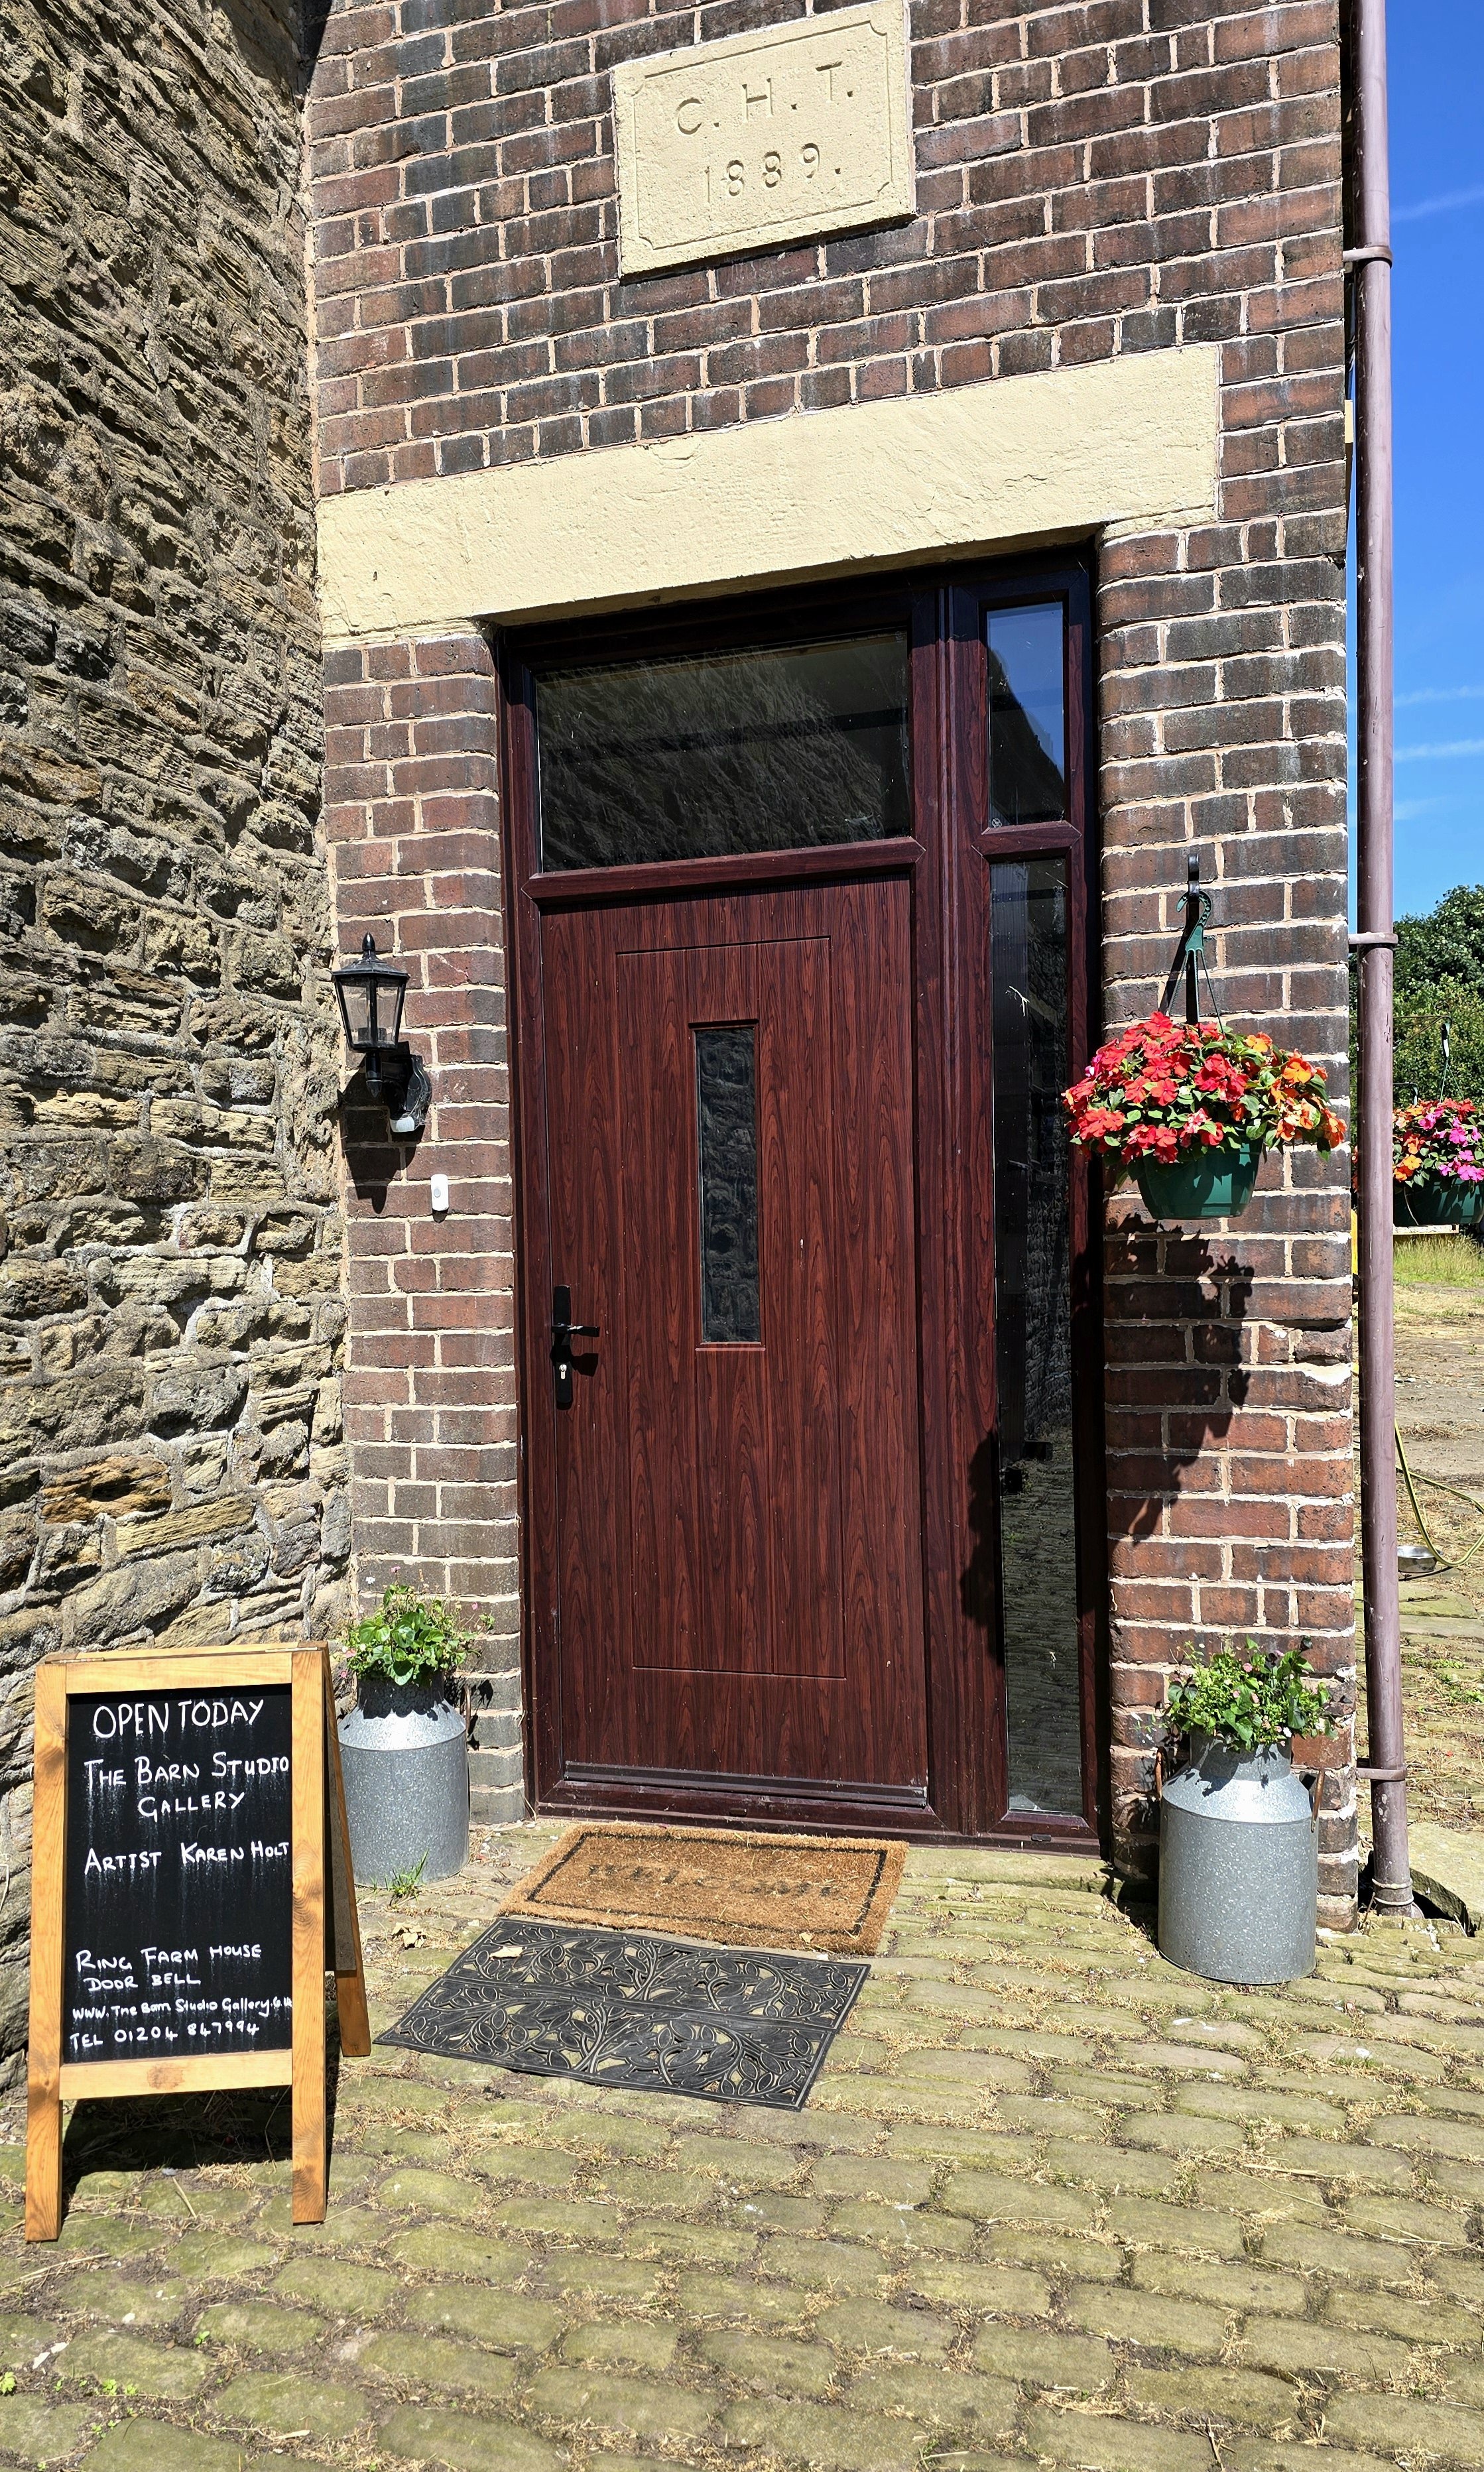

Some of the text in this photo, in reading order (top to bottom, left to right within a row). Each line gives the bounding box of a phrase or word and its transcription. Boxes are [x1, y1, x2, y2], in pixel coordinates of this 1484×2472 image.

[93, 1699, 264, 1739] OPEN TODAY
[84, 1751, 290, 1790] THE BARN STUDIO
[137, 1790, 245, 1822] GALLERY
[84, 1840, 290, 1875] ARTIST KAREN HOLT
[76, 1944, 262, 1972] RING FARM HOUSE
[83, 1972, 201, 1992] DOOR BELL
[70, 2020, 260, 2051] TEL 01204 847994
